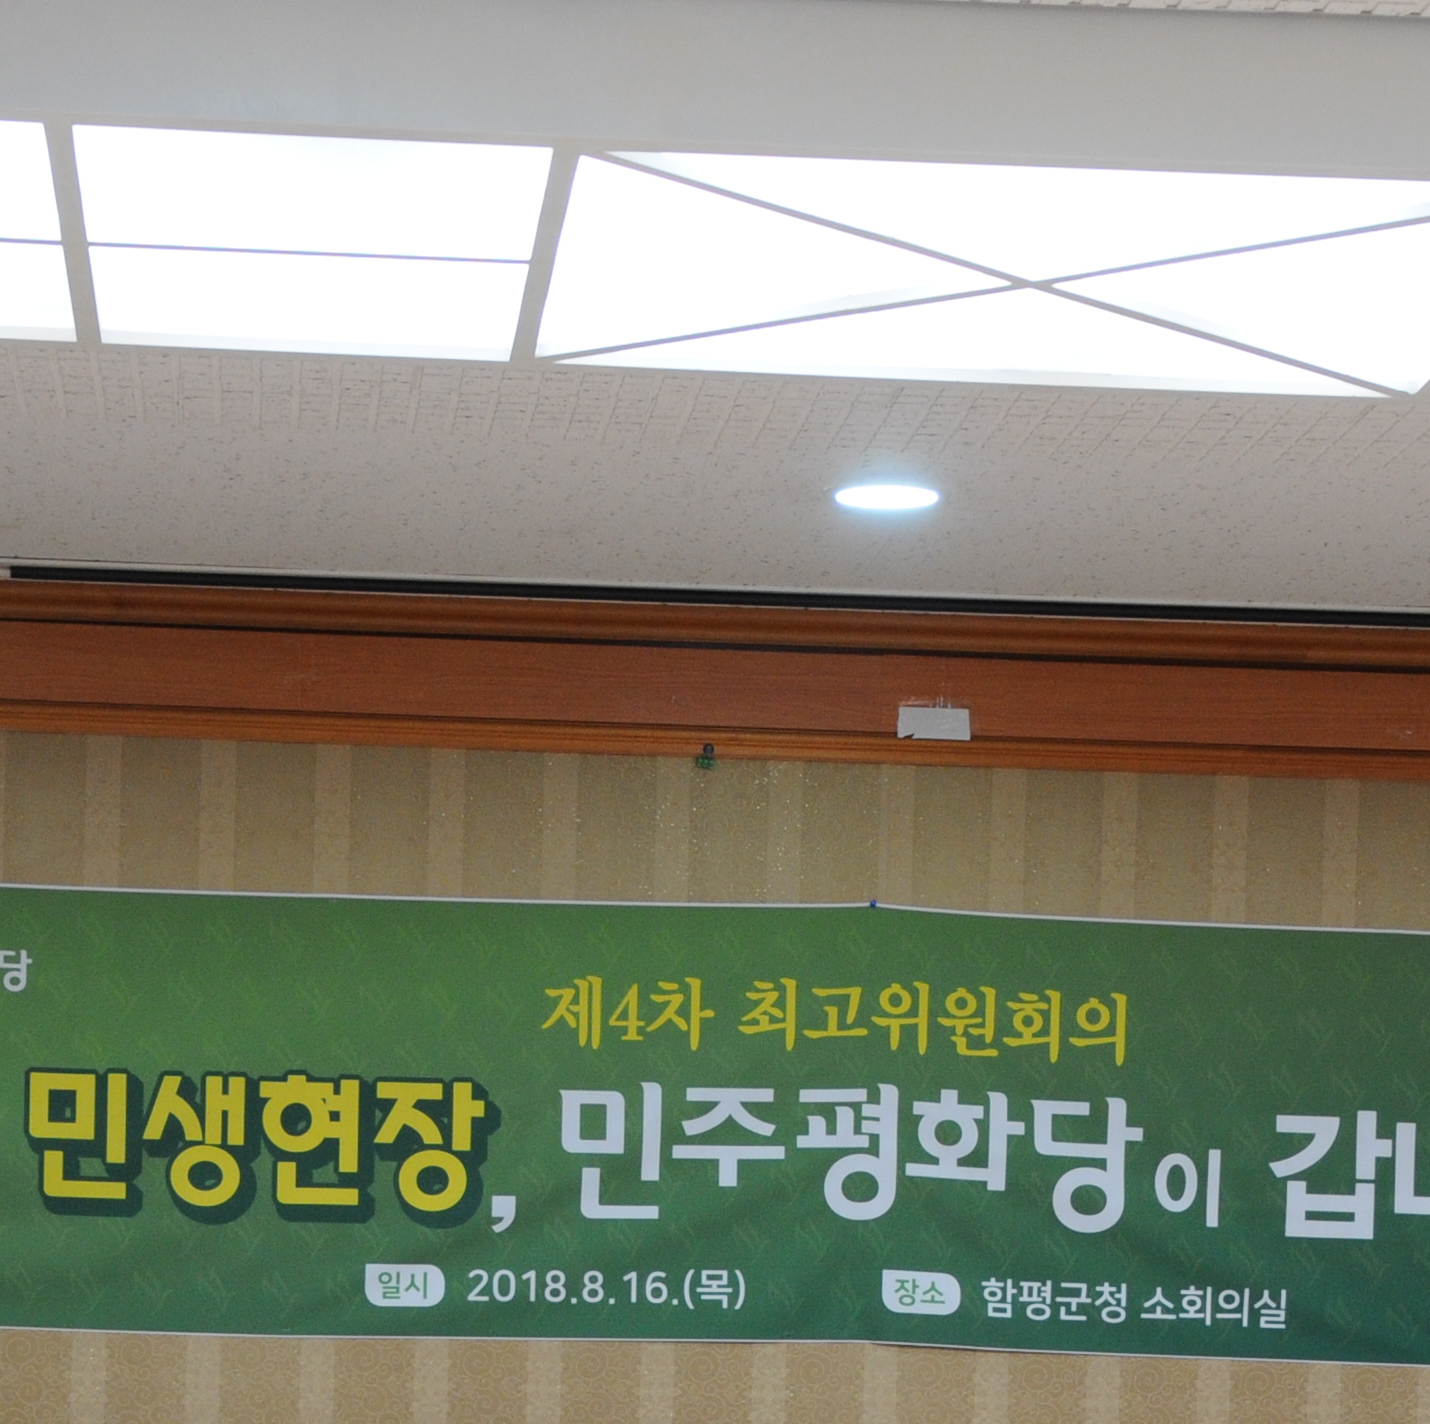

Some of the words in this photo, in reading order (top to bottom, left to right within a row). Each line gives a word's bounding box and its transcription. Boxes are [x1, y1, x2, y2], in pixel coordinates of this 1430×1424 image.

[541, 974, 714, 1051] 제4차
[738, 976, 1129, 1066] 최고위원회의
[25, 1068, 516, 1233] 민생현장,
[559, 1080, 1223, 1235] 민주평화당이
[376, 1269, 431, 1301] 일시
[466, 1267, 748, 1310] 2018.8.16.(목)
[892, 1276, 946, 1308] 장소
[981, 1276, 1129, 1325] 함평군청
[1139, 1285, 1288, 1330] 소회의실
